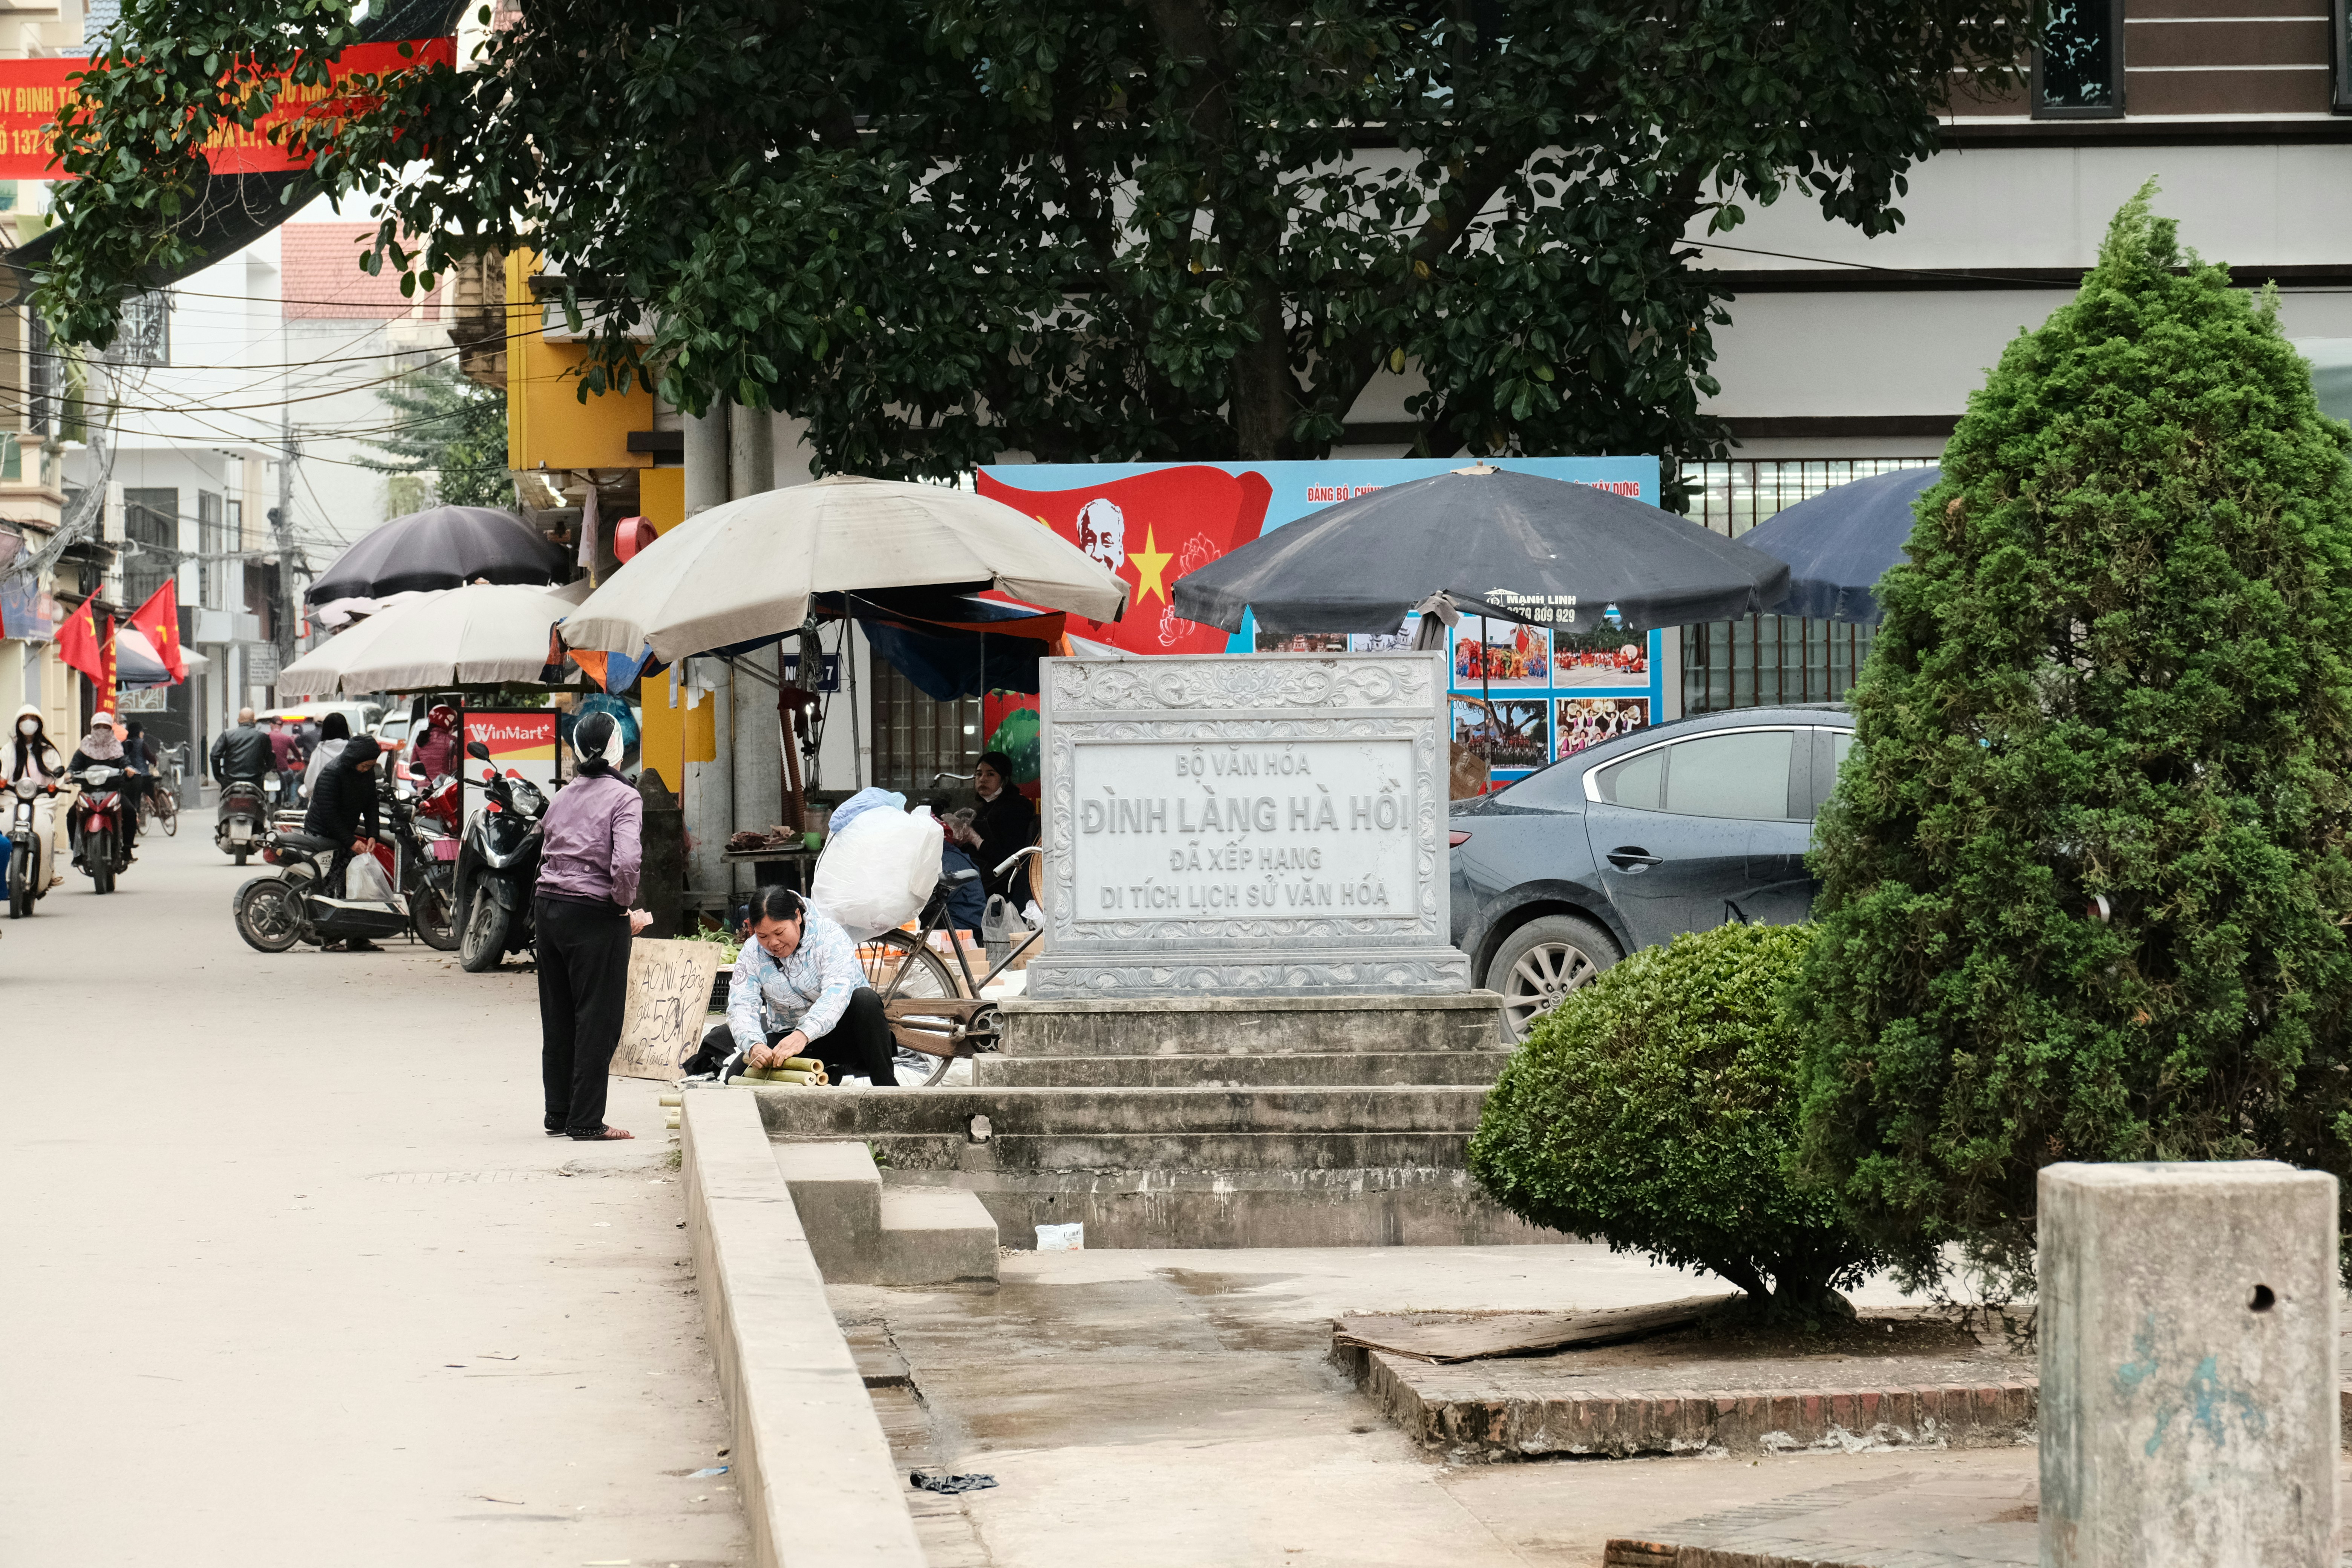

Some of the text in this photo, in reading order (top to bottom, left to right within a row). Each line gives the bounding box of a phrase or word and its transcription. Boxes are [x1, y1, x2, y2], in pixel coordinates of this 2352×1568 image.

[16, 87, 54, 118] ĐỊNH
[12, 129, 40, 154] 137
[1308, 483, 1334, 501] ĐẢNG
[1507, 595, 1544, 606] MẠNH
[1548, 596, 1576, 605] LINH
[1534, 608, 1553, 622] 809
[1556, 608, 1575, 622] 929
[1176, 744, 1312, 783] BỘ VĂN HÓA
[1080, 777, 1409, 833] ĐÌNH LÀNG HÀ HỒI
[1170, 834, 1322, 876] ĐÃ XẾP HẠNG
[1101, 872, 1389, 914] DI TÍCH LỊCH SỬ VĂN HÓA
